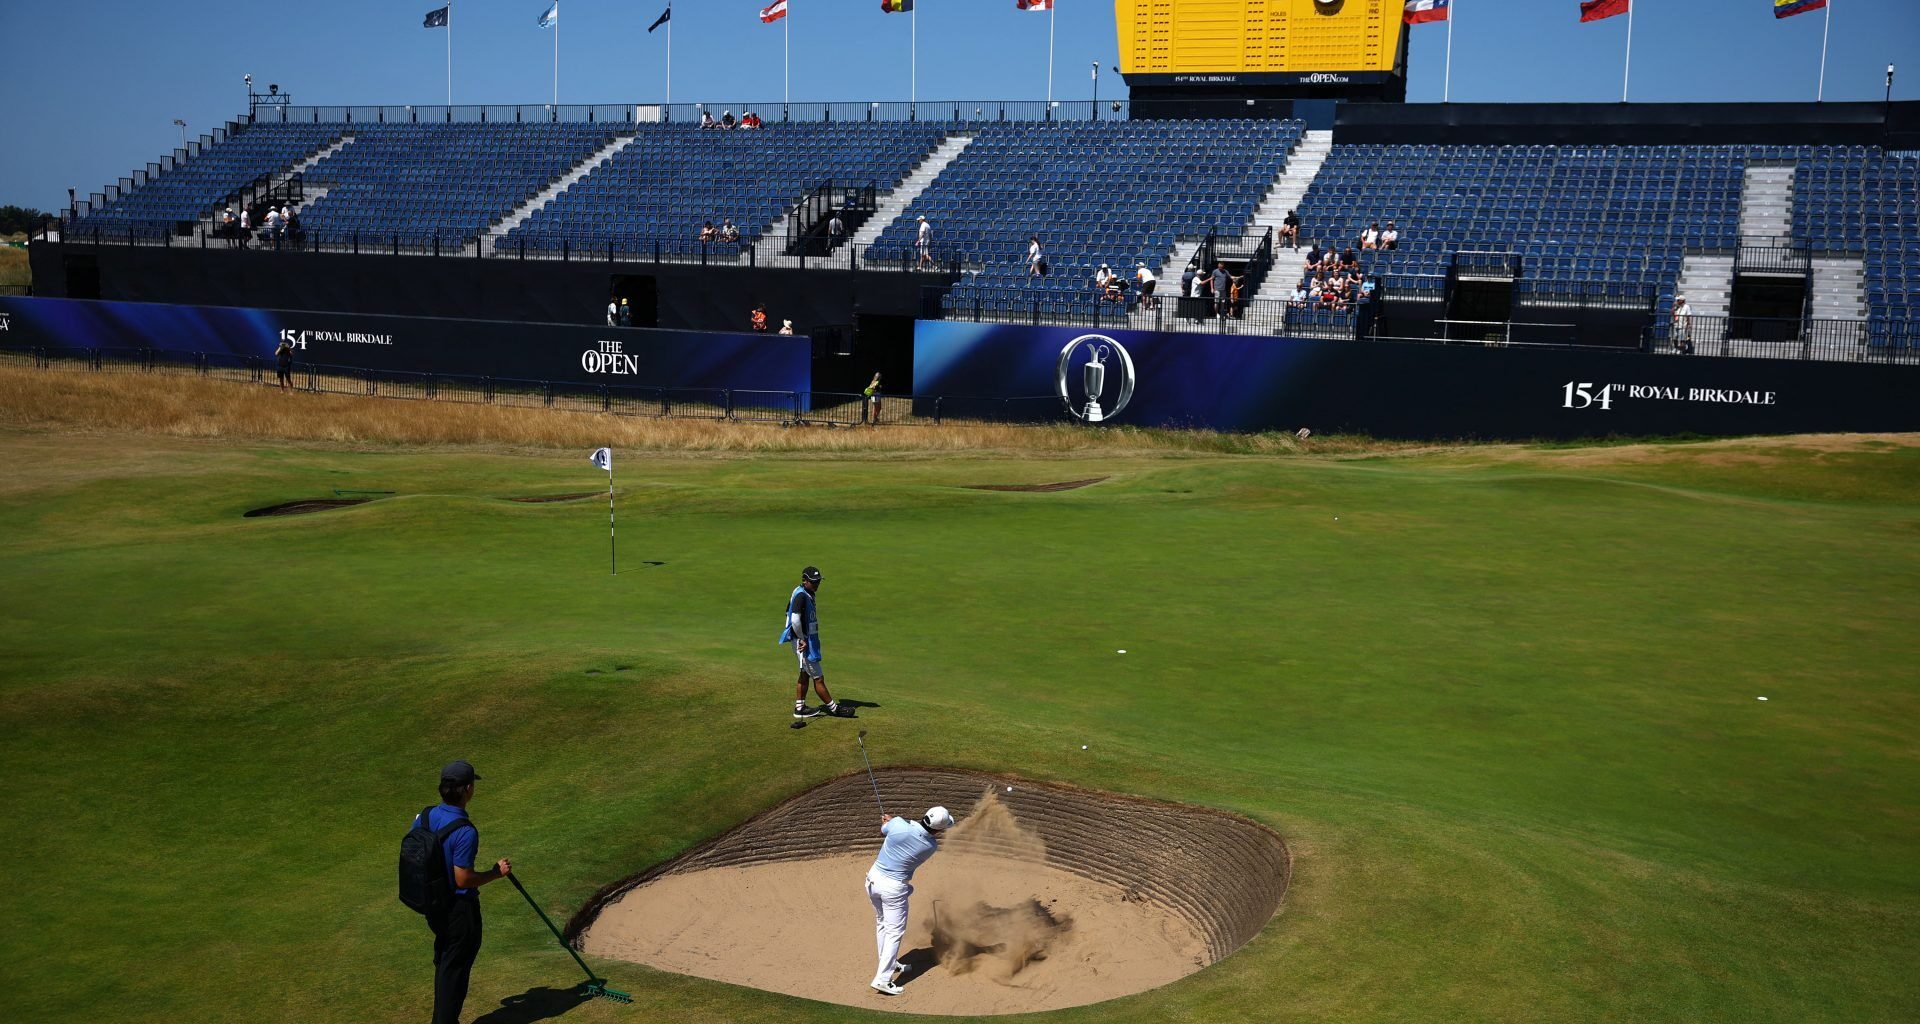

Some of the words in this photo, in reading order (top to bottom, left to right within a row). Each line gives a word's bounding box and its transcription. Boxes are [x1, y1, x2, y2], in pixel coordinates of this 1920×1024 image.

[315, 330, 345, 342] ROYAL
[346, 332, 393, 345] BIRKDALE
[598, 340, 623, 354] THE
[581, 349, 639, 375] OPEN
[1562, 381, 1625, 410] 154TH
[1629, 384, 1684, 401] ROYAL
[1688, 387, 1776, 405] BIRKDALE
